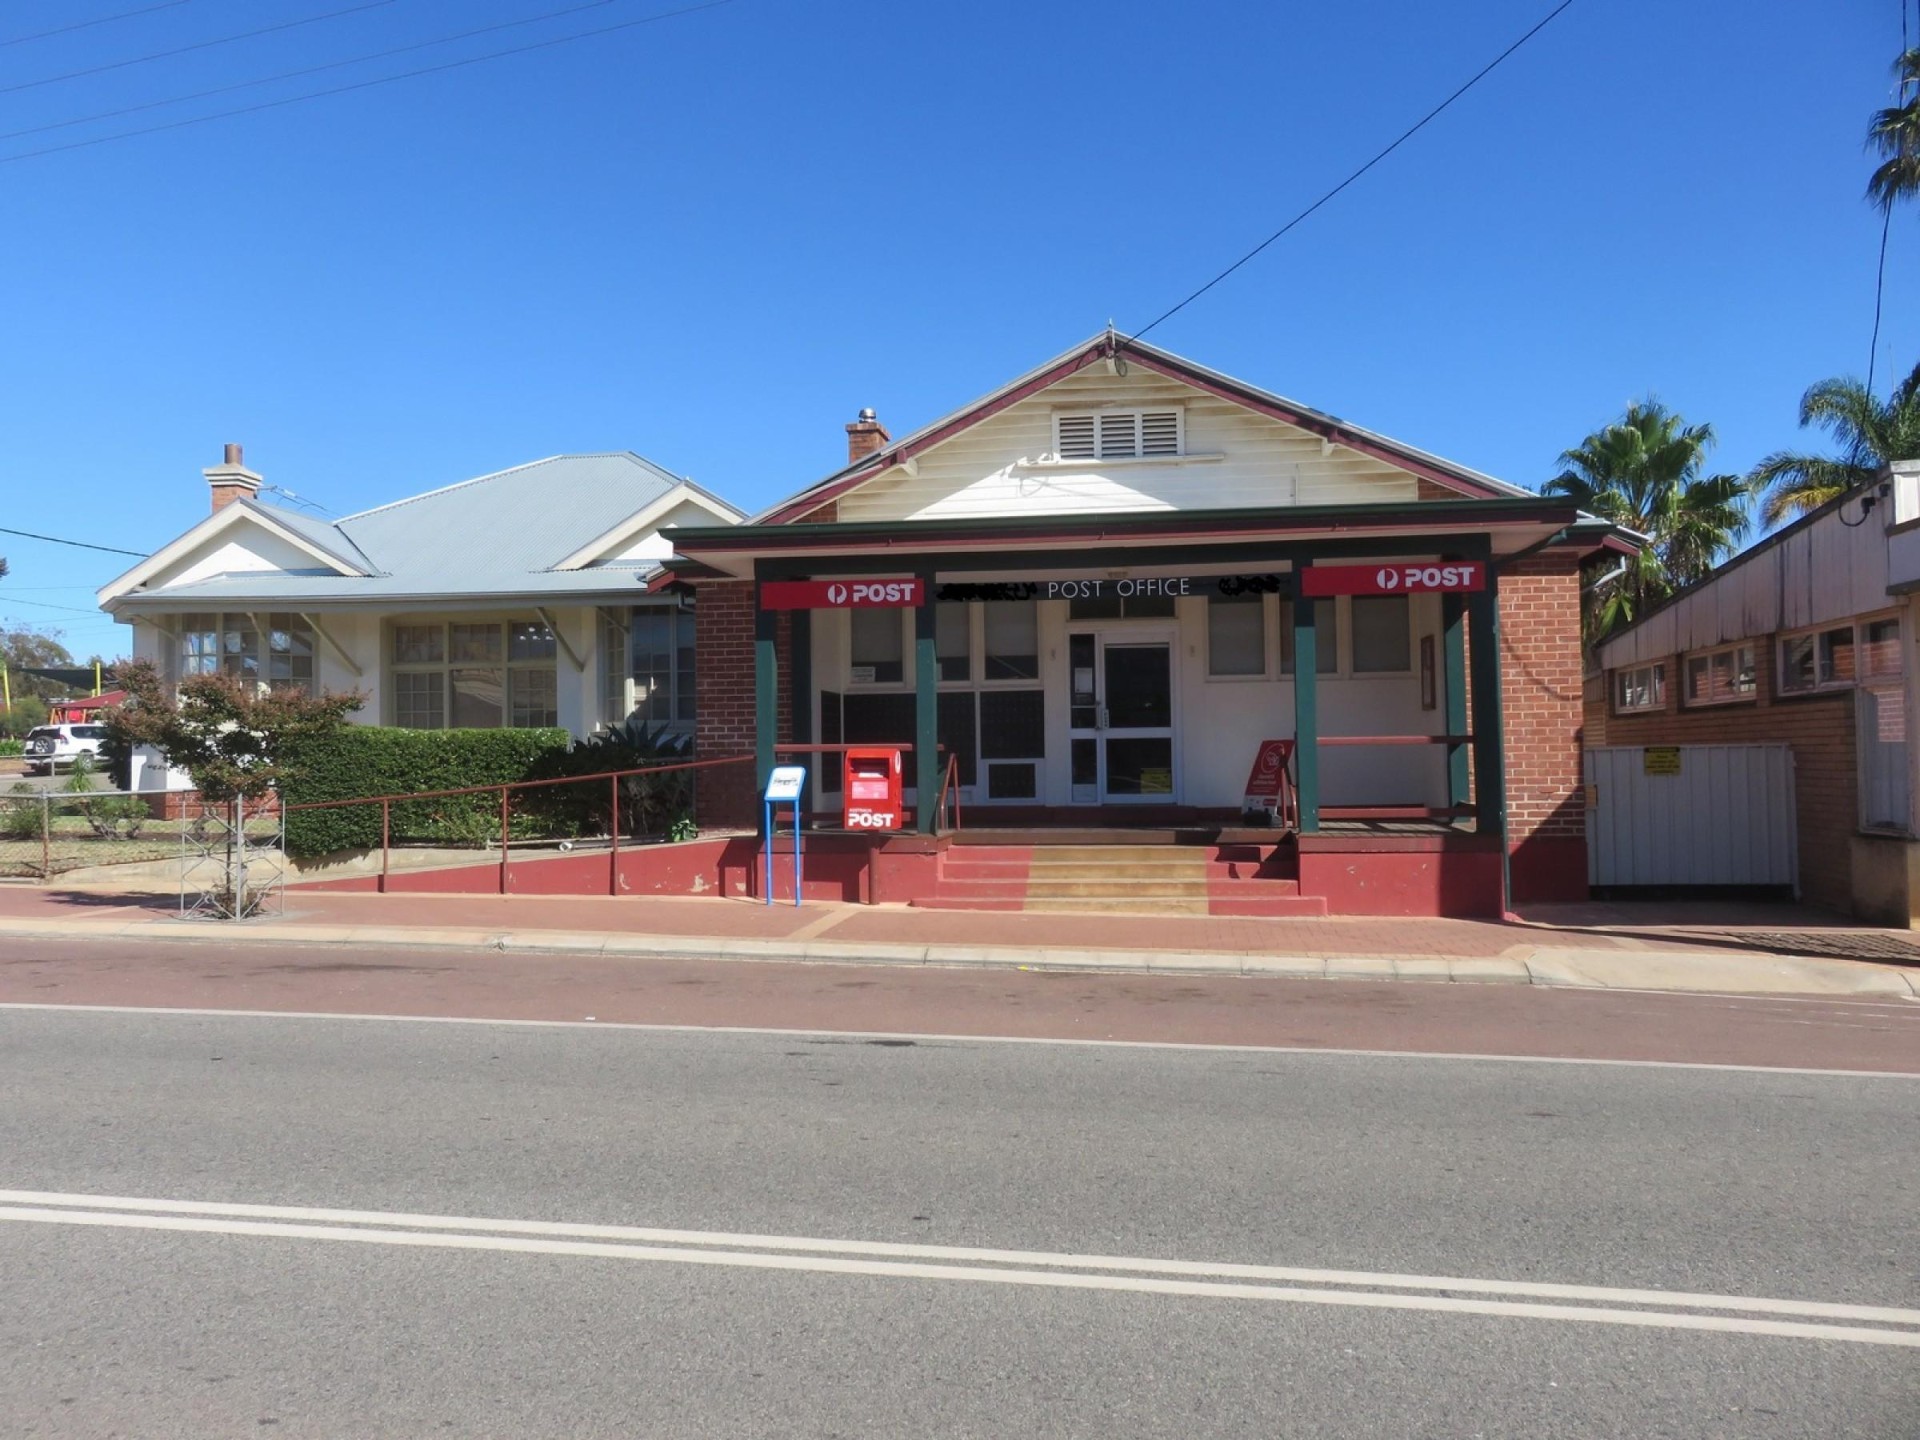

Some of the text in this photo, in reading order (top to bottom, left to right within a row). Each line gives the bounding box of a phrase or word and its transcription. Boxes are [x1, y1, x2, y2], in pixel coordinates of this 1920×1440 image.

[1405, 567, 1475, 587] POST
[852, 583, 915, 602] POST
[1048, 580, 1103, 598] POST
[1116, 578, 1190, 597] OFFICE
[848, 813, 894, 827] POST
